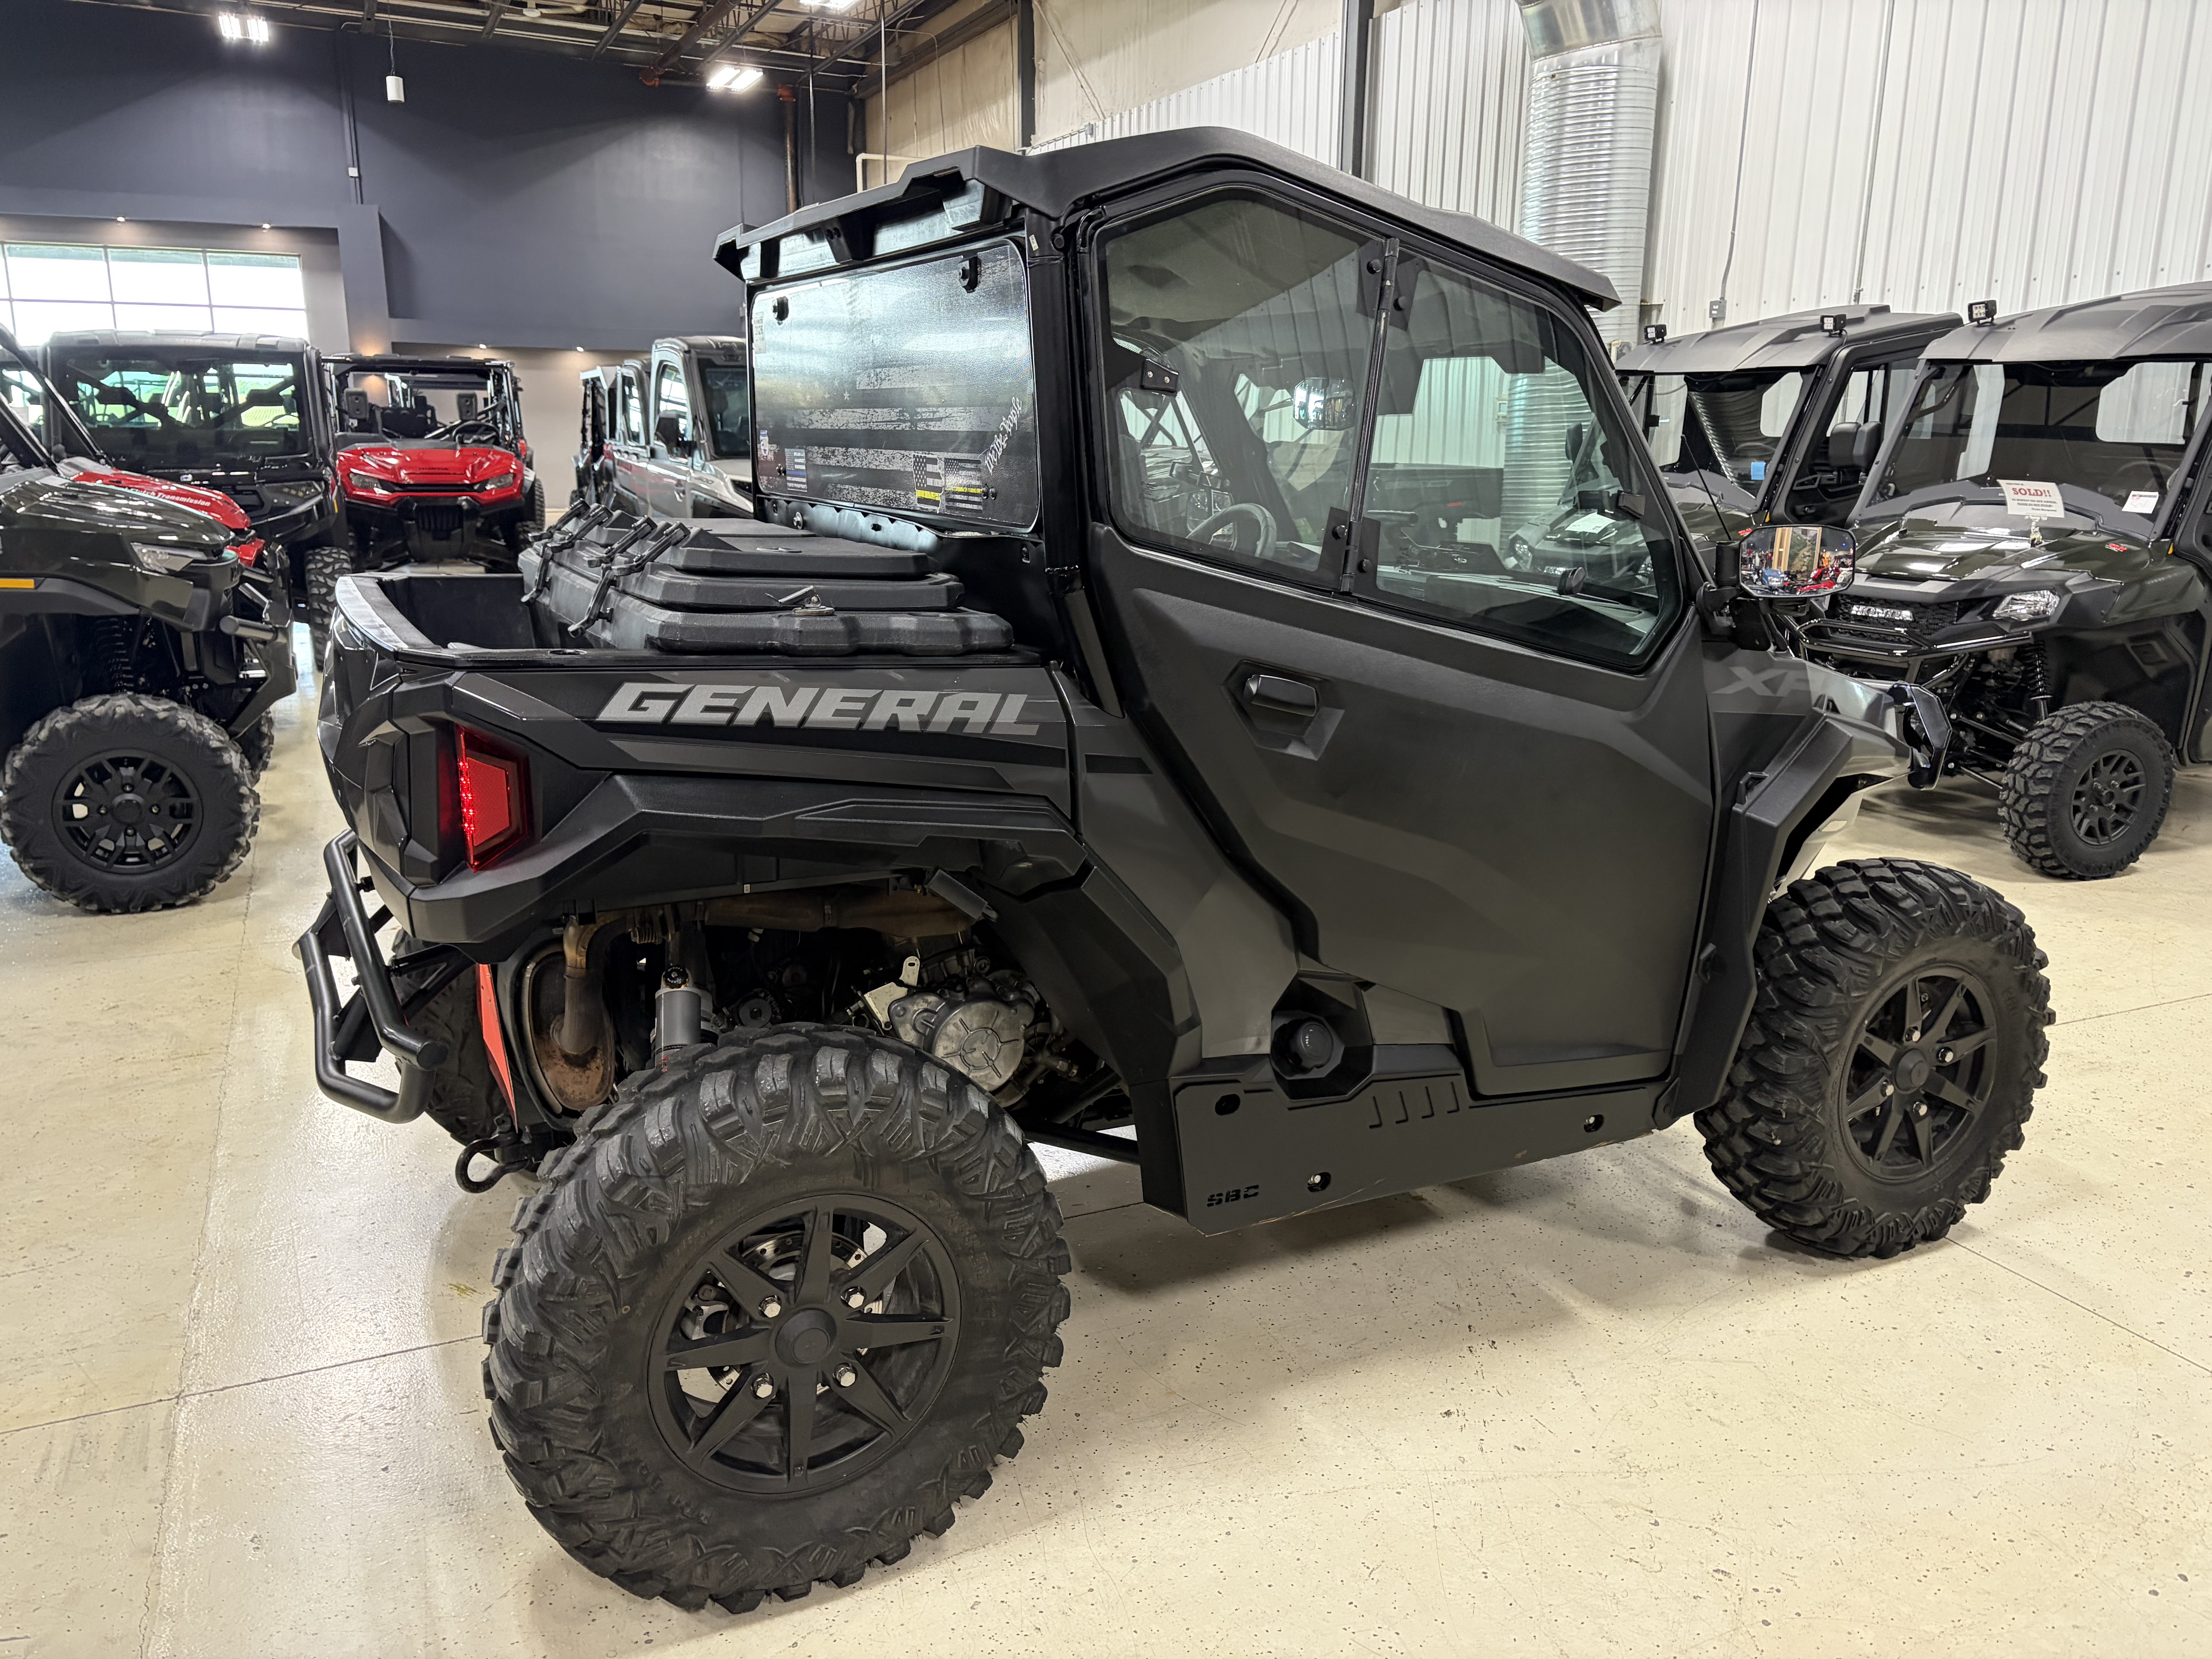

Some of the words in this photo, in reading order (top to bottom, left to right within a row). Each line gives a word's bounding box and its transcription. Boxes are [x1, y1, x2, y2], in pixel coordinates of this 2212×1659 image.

[157, 491, 211, 507] Transmission
[2012, 488, 2051, 497] SOLD!!
[596, 682, 1040, 735] GENERAL
[1206, 1184, 1259, 1207] SBC
